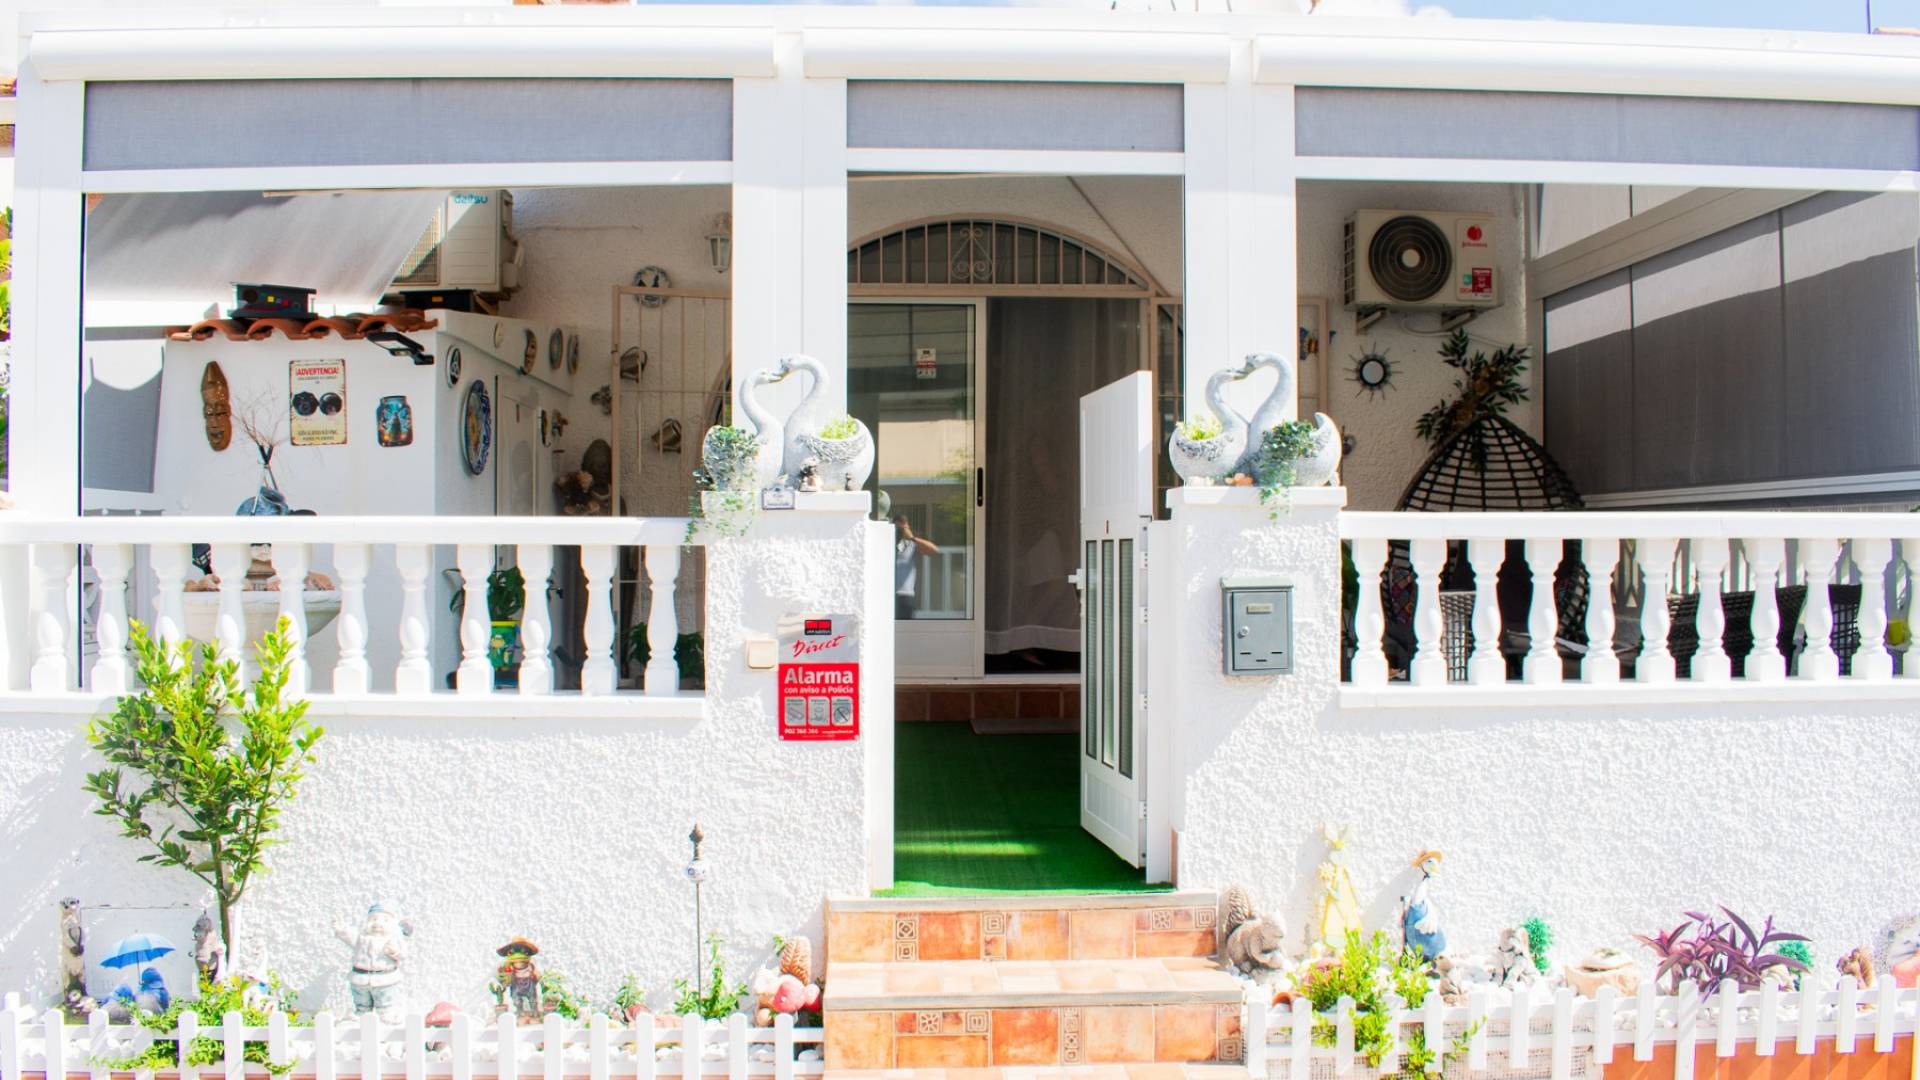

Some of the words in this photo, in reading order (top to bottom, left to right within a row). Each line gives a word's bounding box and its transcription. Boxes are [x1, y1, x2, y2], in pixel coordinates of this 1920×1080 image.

[793, 635, 847, 658] Direct
[784, 666, 853, 684] Alarma
[799, 685, 820, 694] aviso
